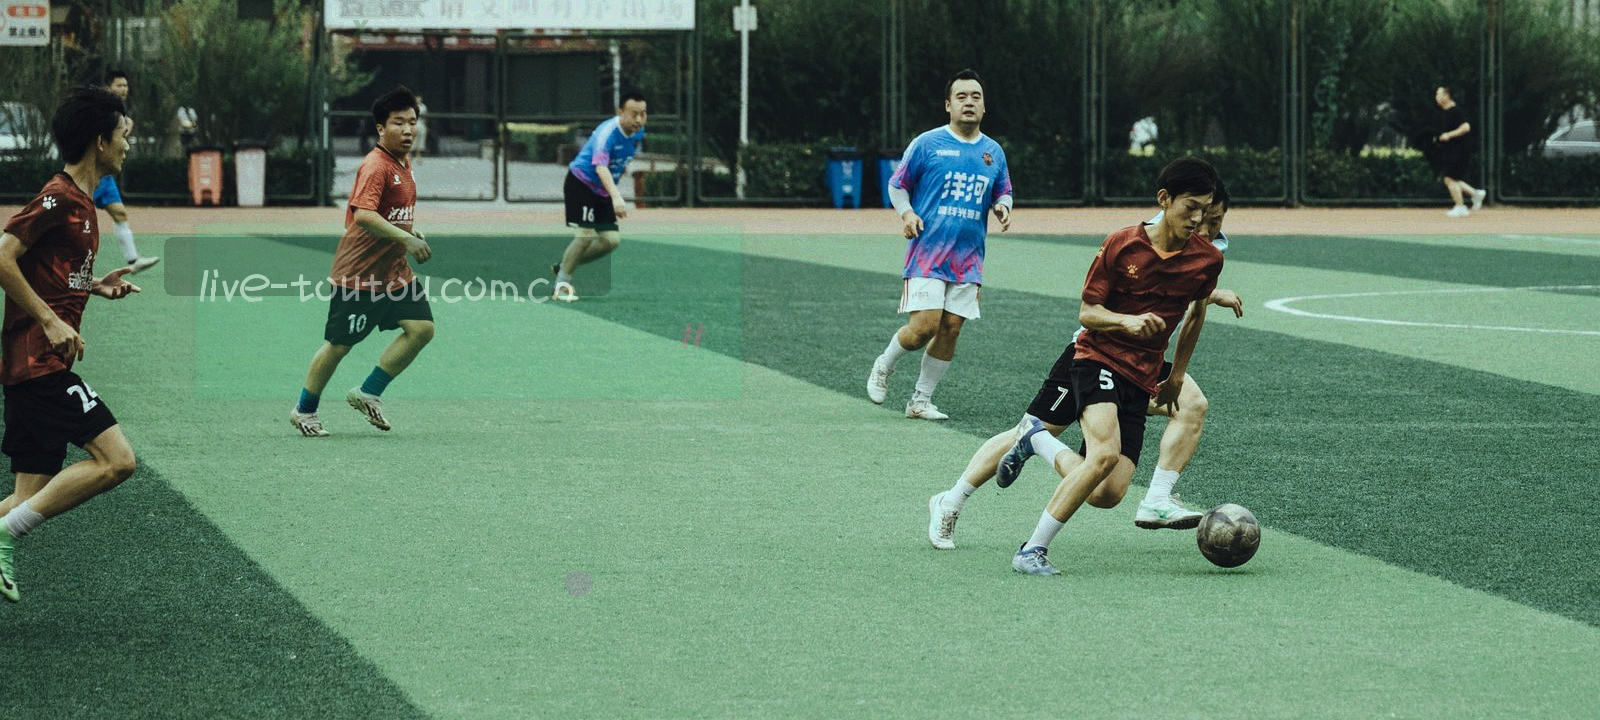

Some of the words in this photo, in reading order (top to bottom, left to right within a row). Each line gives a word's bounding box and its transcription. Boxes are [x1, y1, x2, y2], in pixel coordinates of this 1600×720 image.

[941, 171, 990, 204] 洋河
[582, 205, 595, 222] 16
[348, 313, 368, 335] 10
[1099, 368, 1115, 390] 5
[1050, 386, 1069, 411] 7
